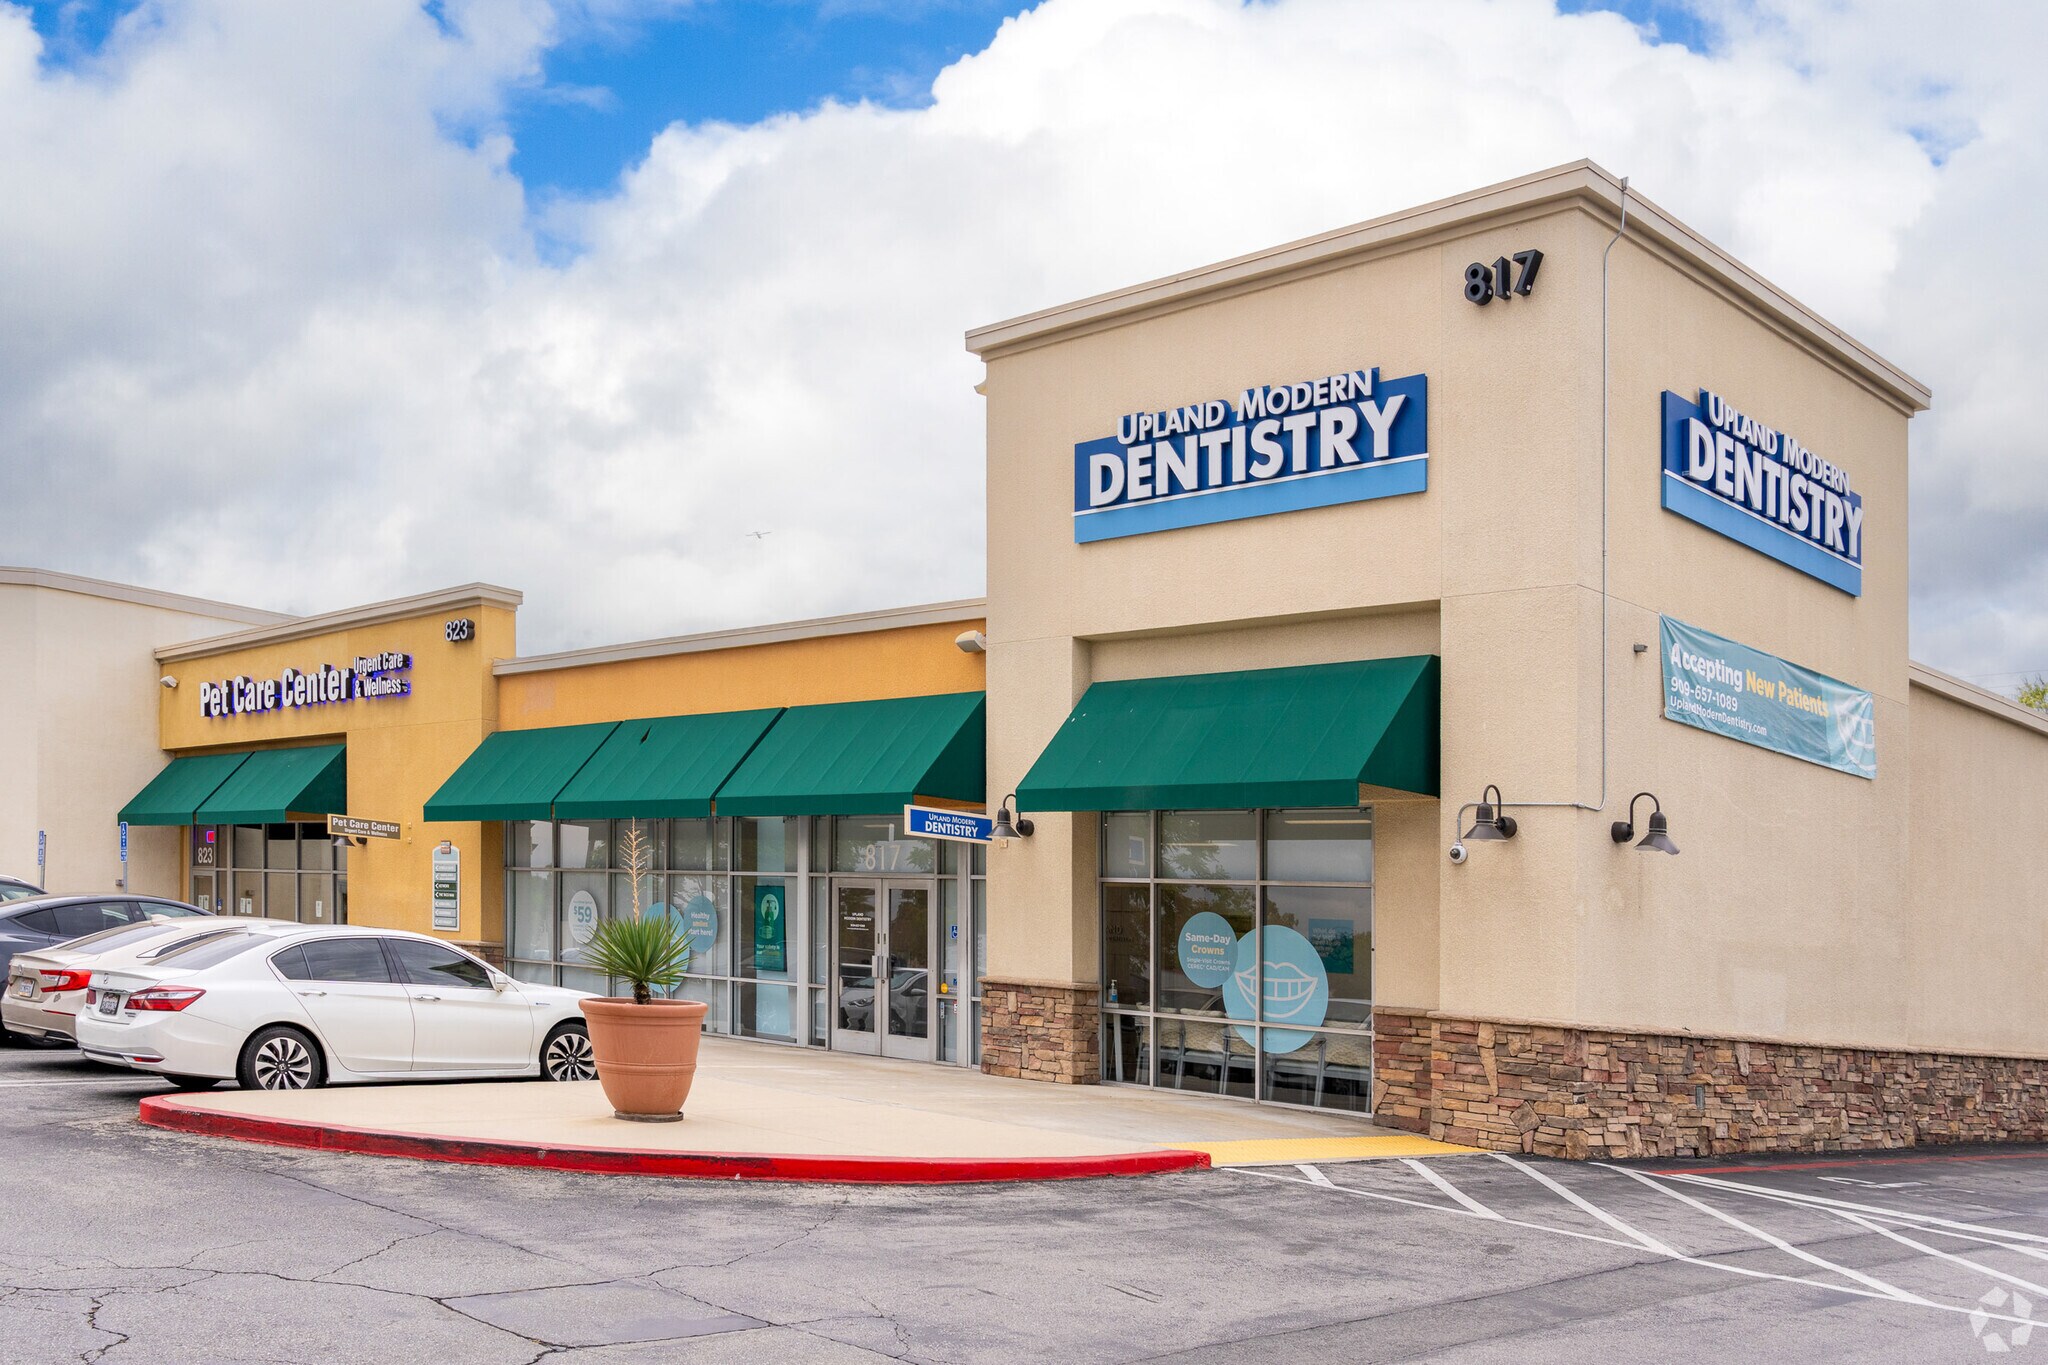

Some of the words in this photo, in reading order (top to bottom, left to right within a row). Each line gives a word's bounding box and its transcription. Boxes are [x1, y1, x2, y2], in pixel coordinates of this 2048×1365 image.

[1465, 249, 1544, 306] 817
[1117, 400, 1226, 446] UPLAND
[1237, 369, 1374, 421] MODERN
[1089, 394, 1406, 507] DENTISTRY
[1708, 391, 1778, 455] UPLAND
[1783, 434, 1850, 496] MODERN
[1688, 417, 1864, 558] DENTISTRY
[445, 618, 471, 642] 823
[353, 653, 382, 676] Urgent
[383, 651, 403, 670] Care
[200, 679, 229, 717] Pet
[233, 675, 275, 714] Care
[282, 663, 350, 707] Center
[354, 679, 362, 698] &
[364, 676, 402, 697] Wellness
[1671, 642, 1743, 692] Accepting
[1745, 669, 1775, 699] New
[1778, 680, 1830, 717] Patients
[1671, 676, 1738, 711] 909-657-1089
[332, 817, 347, 827] Pet
[349, 819, 369, 829] Care
[371, 822, 399, 833] Center
[925, 820, 979, 838] DENTISTRY
[928, 813, 951, 823] UPLAND
[951, 816, 976, 826] MODERN
[198, 847, 213, 864] 823
[865, 844, 900, 871] 817
[573, 905, 592, 924] $59
[690, 911, 711, 921] Healthy
[1185, 932, 1231, 945] Same-Day
[1191, 944, 1225, 955] Crowns
